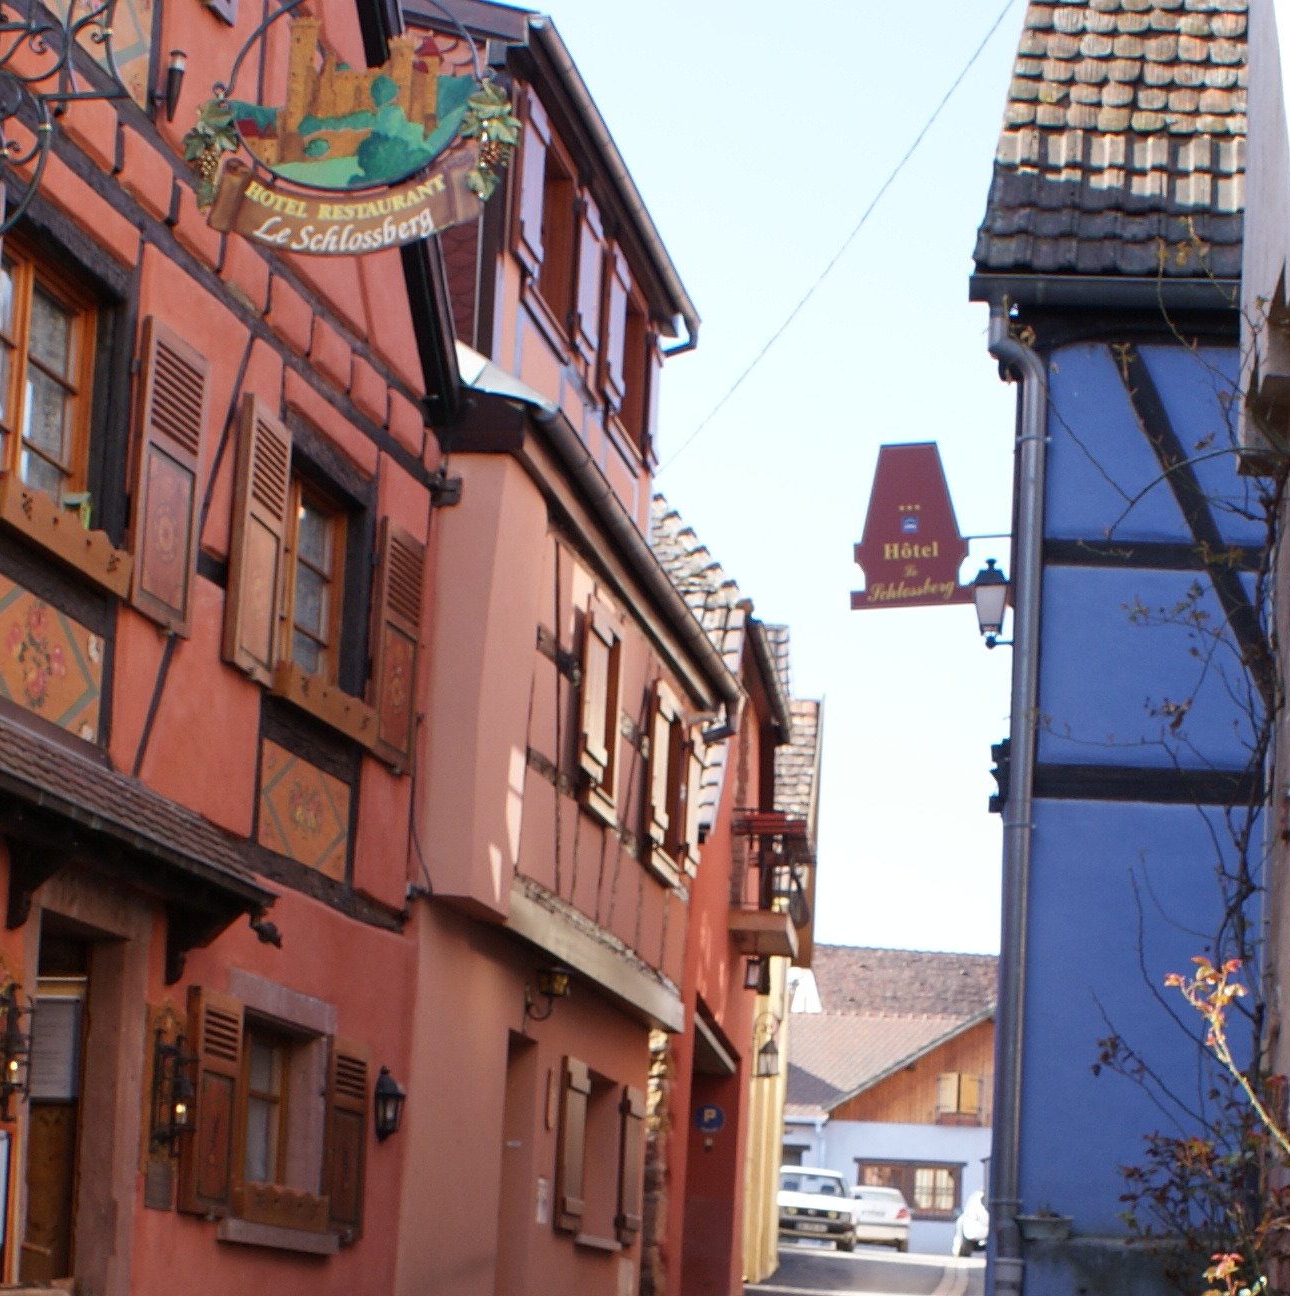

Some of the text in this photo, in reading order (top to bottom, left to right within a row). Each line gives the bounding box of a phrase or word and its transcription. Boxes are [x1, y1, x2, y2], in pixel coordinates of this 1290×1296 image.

[245, 174, 446, 221] HOTEL RESTAURANT
[253, 208, 435, 252] Le Schlossberg
[884, 541, 939, 560] Hôtel
[704, 1108, 717, 1122] P
